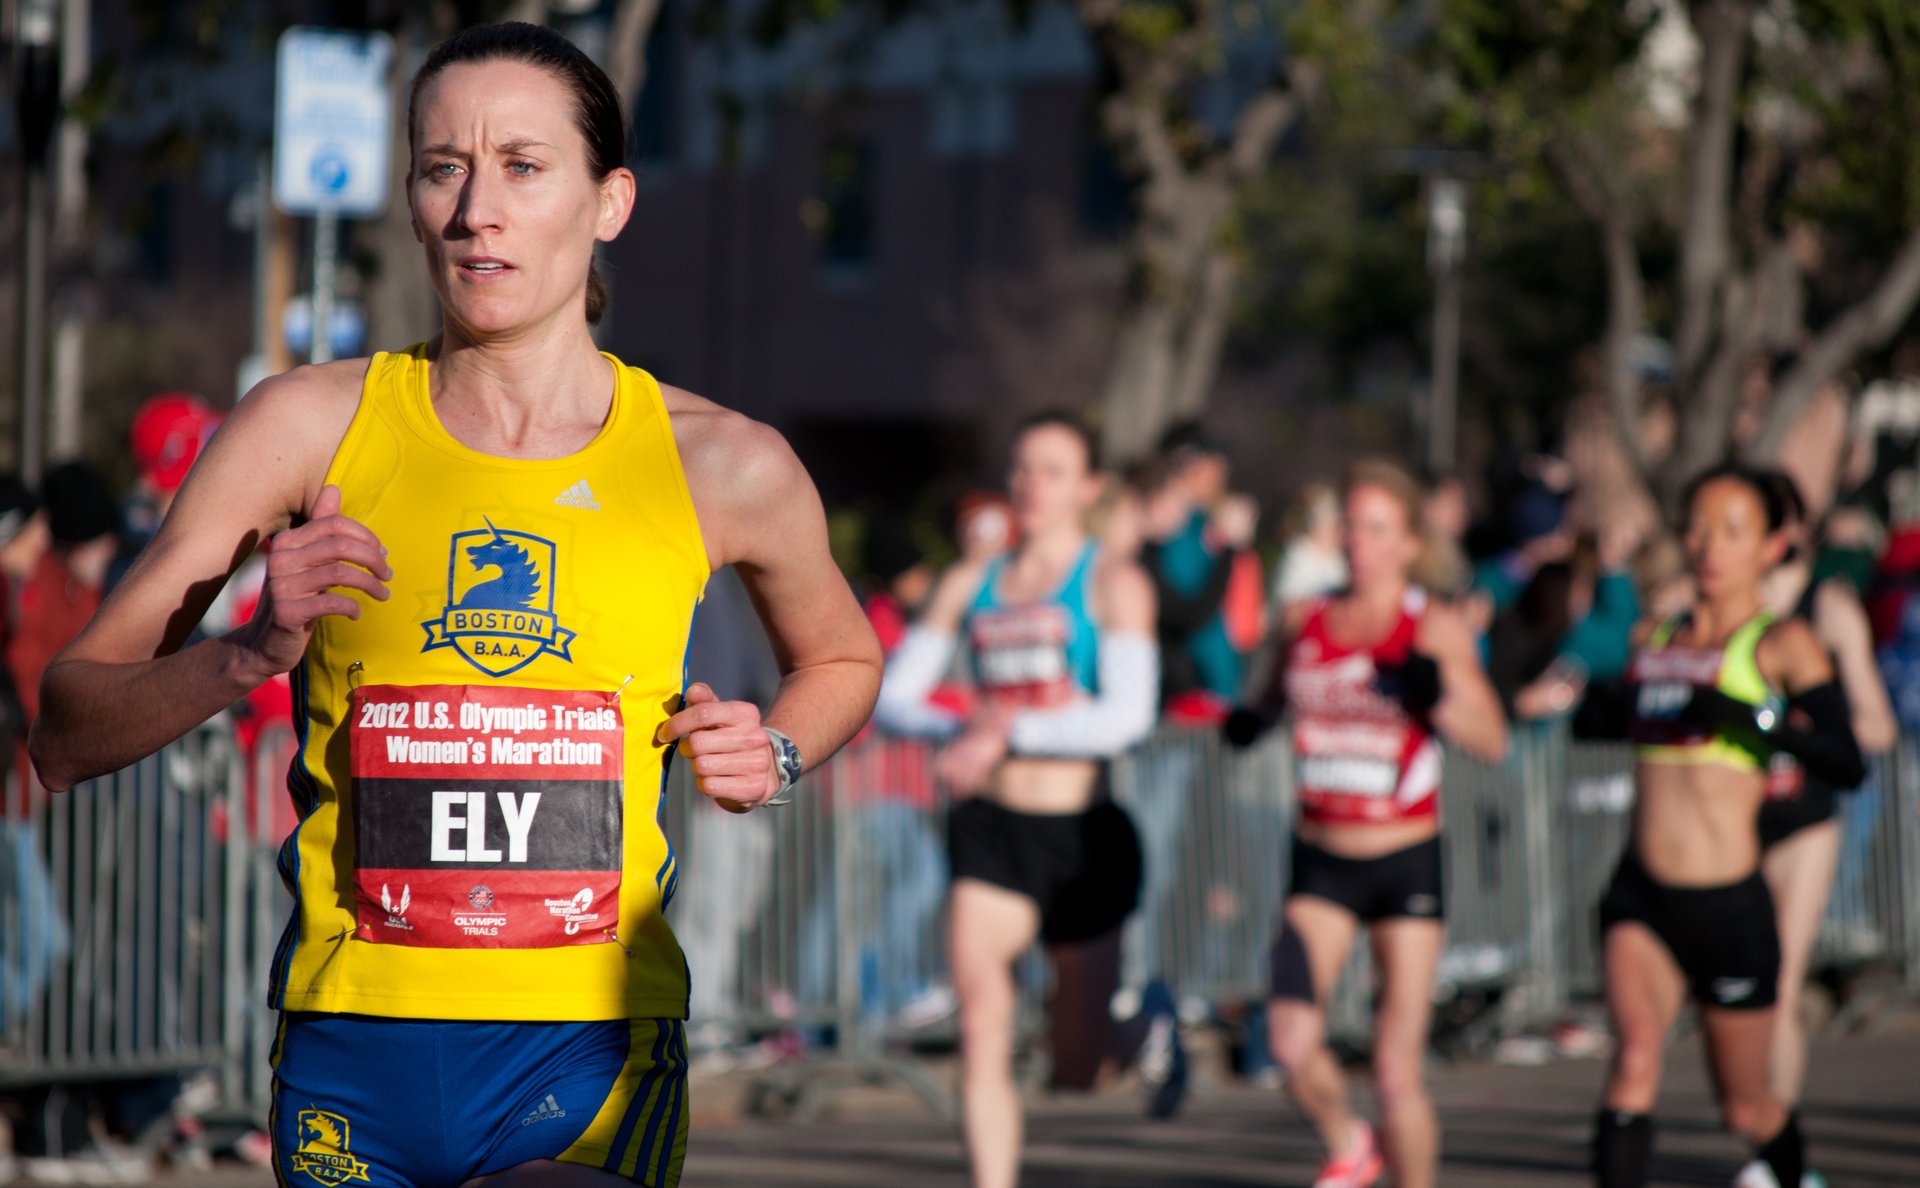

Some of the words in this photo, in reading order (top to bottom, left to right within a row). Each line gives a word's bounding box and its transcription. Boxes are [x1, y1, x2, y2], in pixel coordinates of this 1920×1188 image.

[454, 612, 543, 634] BOSTON
[474, 641, 526, 658] B.A.A.
[359, 702, 409, 729] 2012
[414, 702, 454, 729] U.S.
[460, 702, 547, 734] Olympic
[552, 705, 617, 731] Trials
[386, 735, 486, 764] Women's
[491, 737, 602, 766] Marathon
[430, 791, 542, 863] ELY
[454, 916, 507, 926] OLYMPIC
[462, 926, 498, 936] TRIALS
[521, 1109, 566, 1127] adidas
[315, 1167, 342, 1179] B.A.A.
